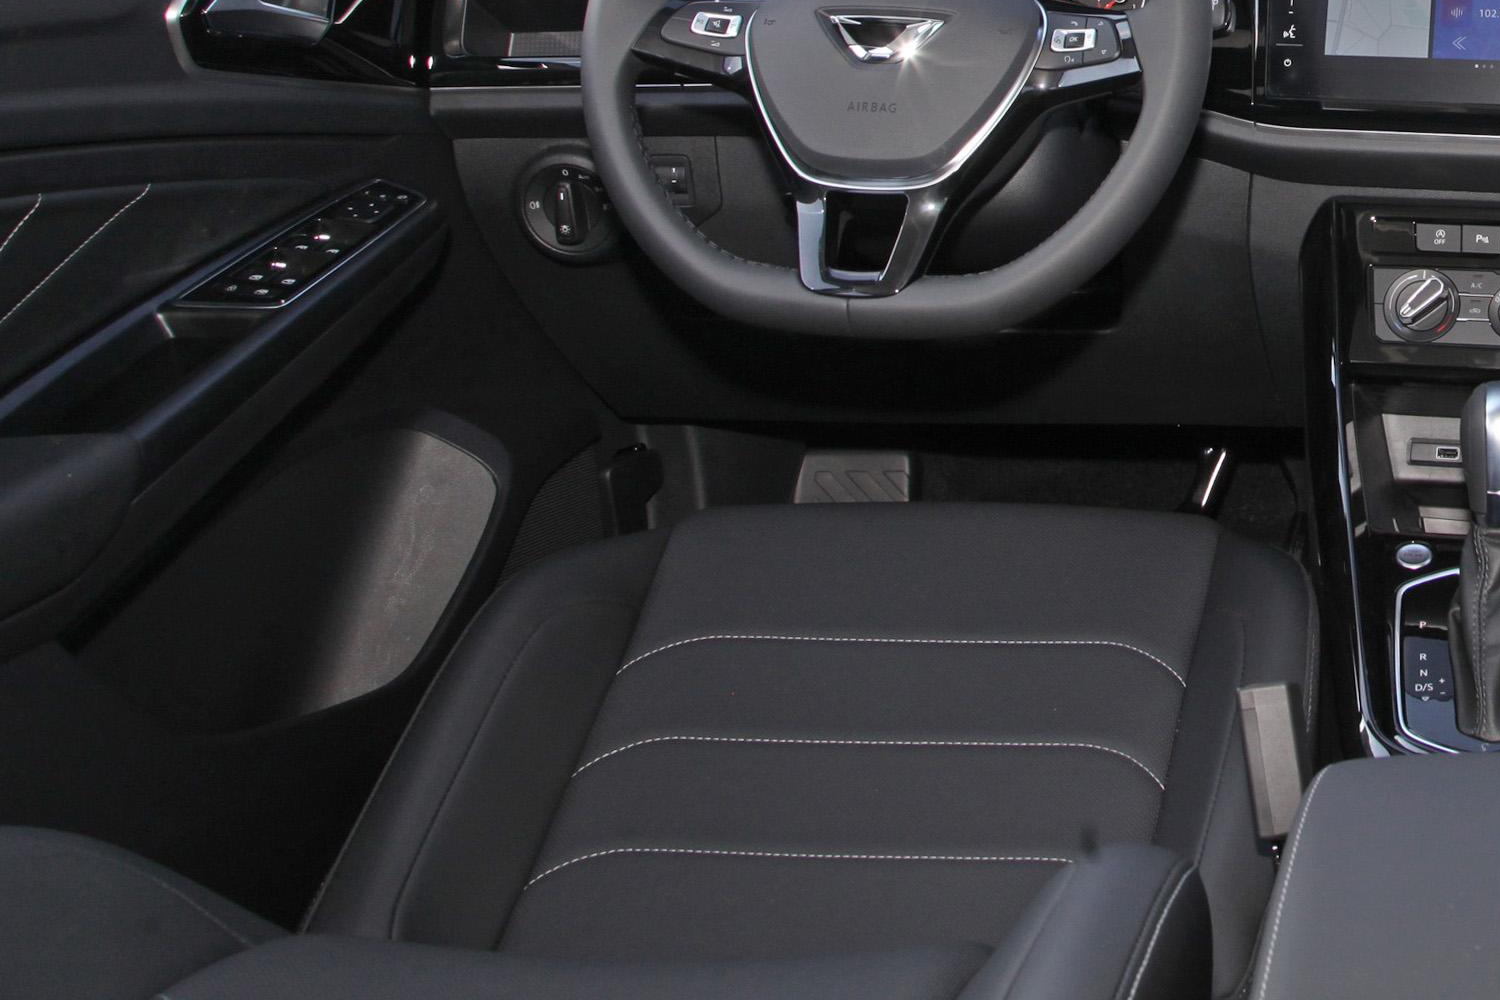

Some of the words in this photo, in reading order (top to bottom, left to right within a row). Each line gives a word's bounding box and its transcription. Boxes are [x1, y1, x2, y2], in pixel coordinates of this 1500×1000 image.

[847, 101, 898, 113] AIRBAG
[1419, 621, 1427, 629] P
[1419, 653, 1427, 661] R
[1414, 683, 1434, 692] D/S
